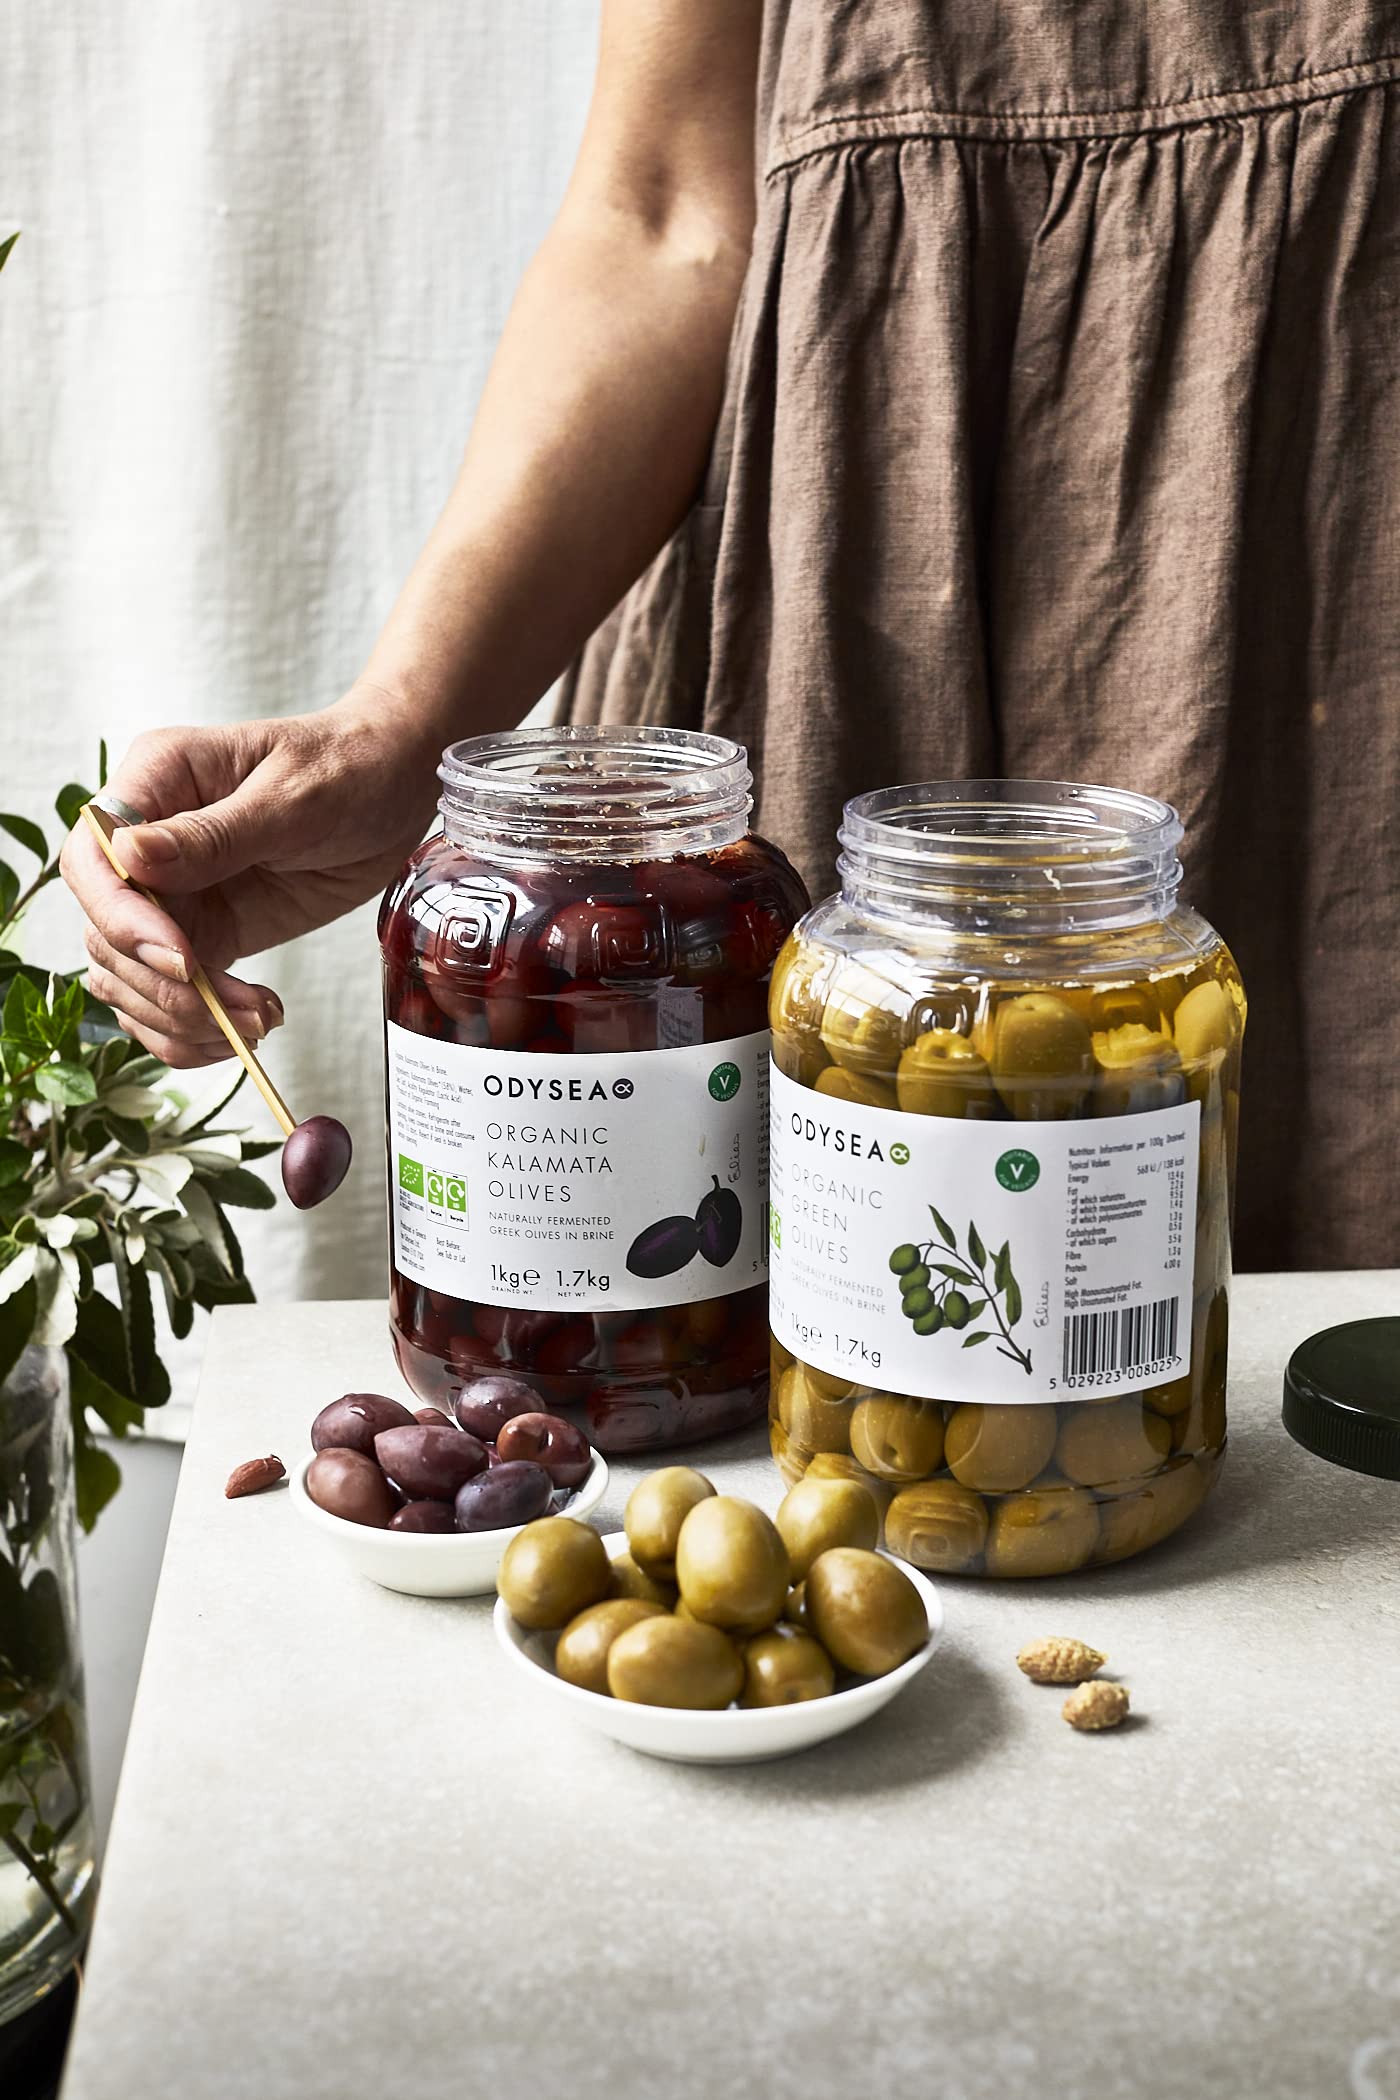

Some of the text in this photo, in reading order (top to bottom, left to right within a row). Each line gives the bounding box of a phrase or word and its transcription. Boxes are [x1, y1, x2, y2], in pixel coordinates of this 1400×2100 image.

[484, 1075, 608, 1101] ODYSEA
[719, 1074, 730, 1091] V
[486, 1122, 608, 1145] ORGANIC
[791, 1112, 885, 1164] ODYSEA
[1069, 1148, 1096, 1157] Nutrition
[1100, 1144, 1134, 1154] Information
[1136, 1142, 1146, 1151] per
[488, 1152, 613, 1174] KALAMATA
[1092, 1158, 1110, 1168] Values
[1010, 1163, 1024, 1181] V
[1068, 1174, 1090, 1184] Energy
[488, 1180, 572, 1202] OLIVES
[792, 1163, 884, 1210] ORGANIC
[1067, 1186, 1078, 1196] Fat
[1080, 1195, 1097, 1204] which
[792, 1194, 848, 1232] GREEN
[1080, 1204, 1097, 1214] which
[488, 1210, 611, 1226] NATURALLY FERMENTED
[1080, 1215, 1097, 1224] which
[488, 1226, 614, 1240] GREEK OLIVES IN BRINE
[1066, 1226, 1107, 1238] Carbohydrate
[792, 1225, 849, 1264] OLIVES
[1078, 1238, 1096, 1246] which
[1066, 1251, 1082, 1260] Fibre
[752, 1261, 758, 1272] 5
[1066, 1264, 1087, 1272] Protein
[556, 1269, 610, 1292] 1.7kg
[828, 1274, 884, 1298] FERMENTED
[1064, 1276, 1078, 1286] Salt
[812, 1282, 840, 1303] OLIVES
[842, 1295, 854, 1306] IN
[857, 1299, 887, 1315] BRINE
[1064, 1289, 1079, 1299] High
[1064, 1299, 1079, 1310] High
[834, 1334, 882, 1368] 1.7kg
[1049, 1378, 1056, 1390] 5
[1068, 1370, 1121, 1389] 029223
[1128, 1357, 1172, 1380] 008025
